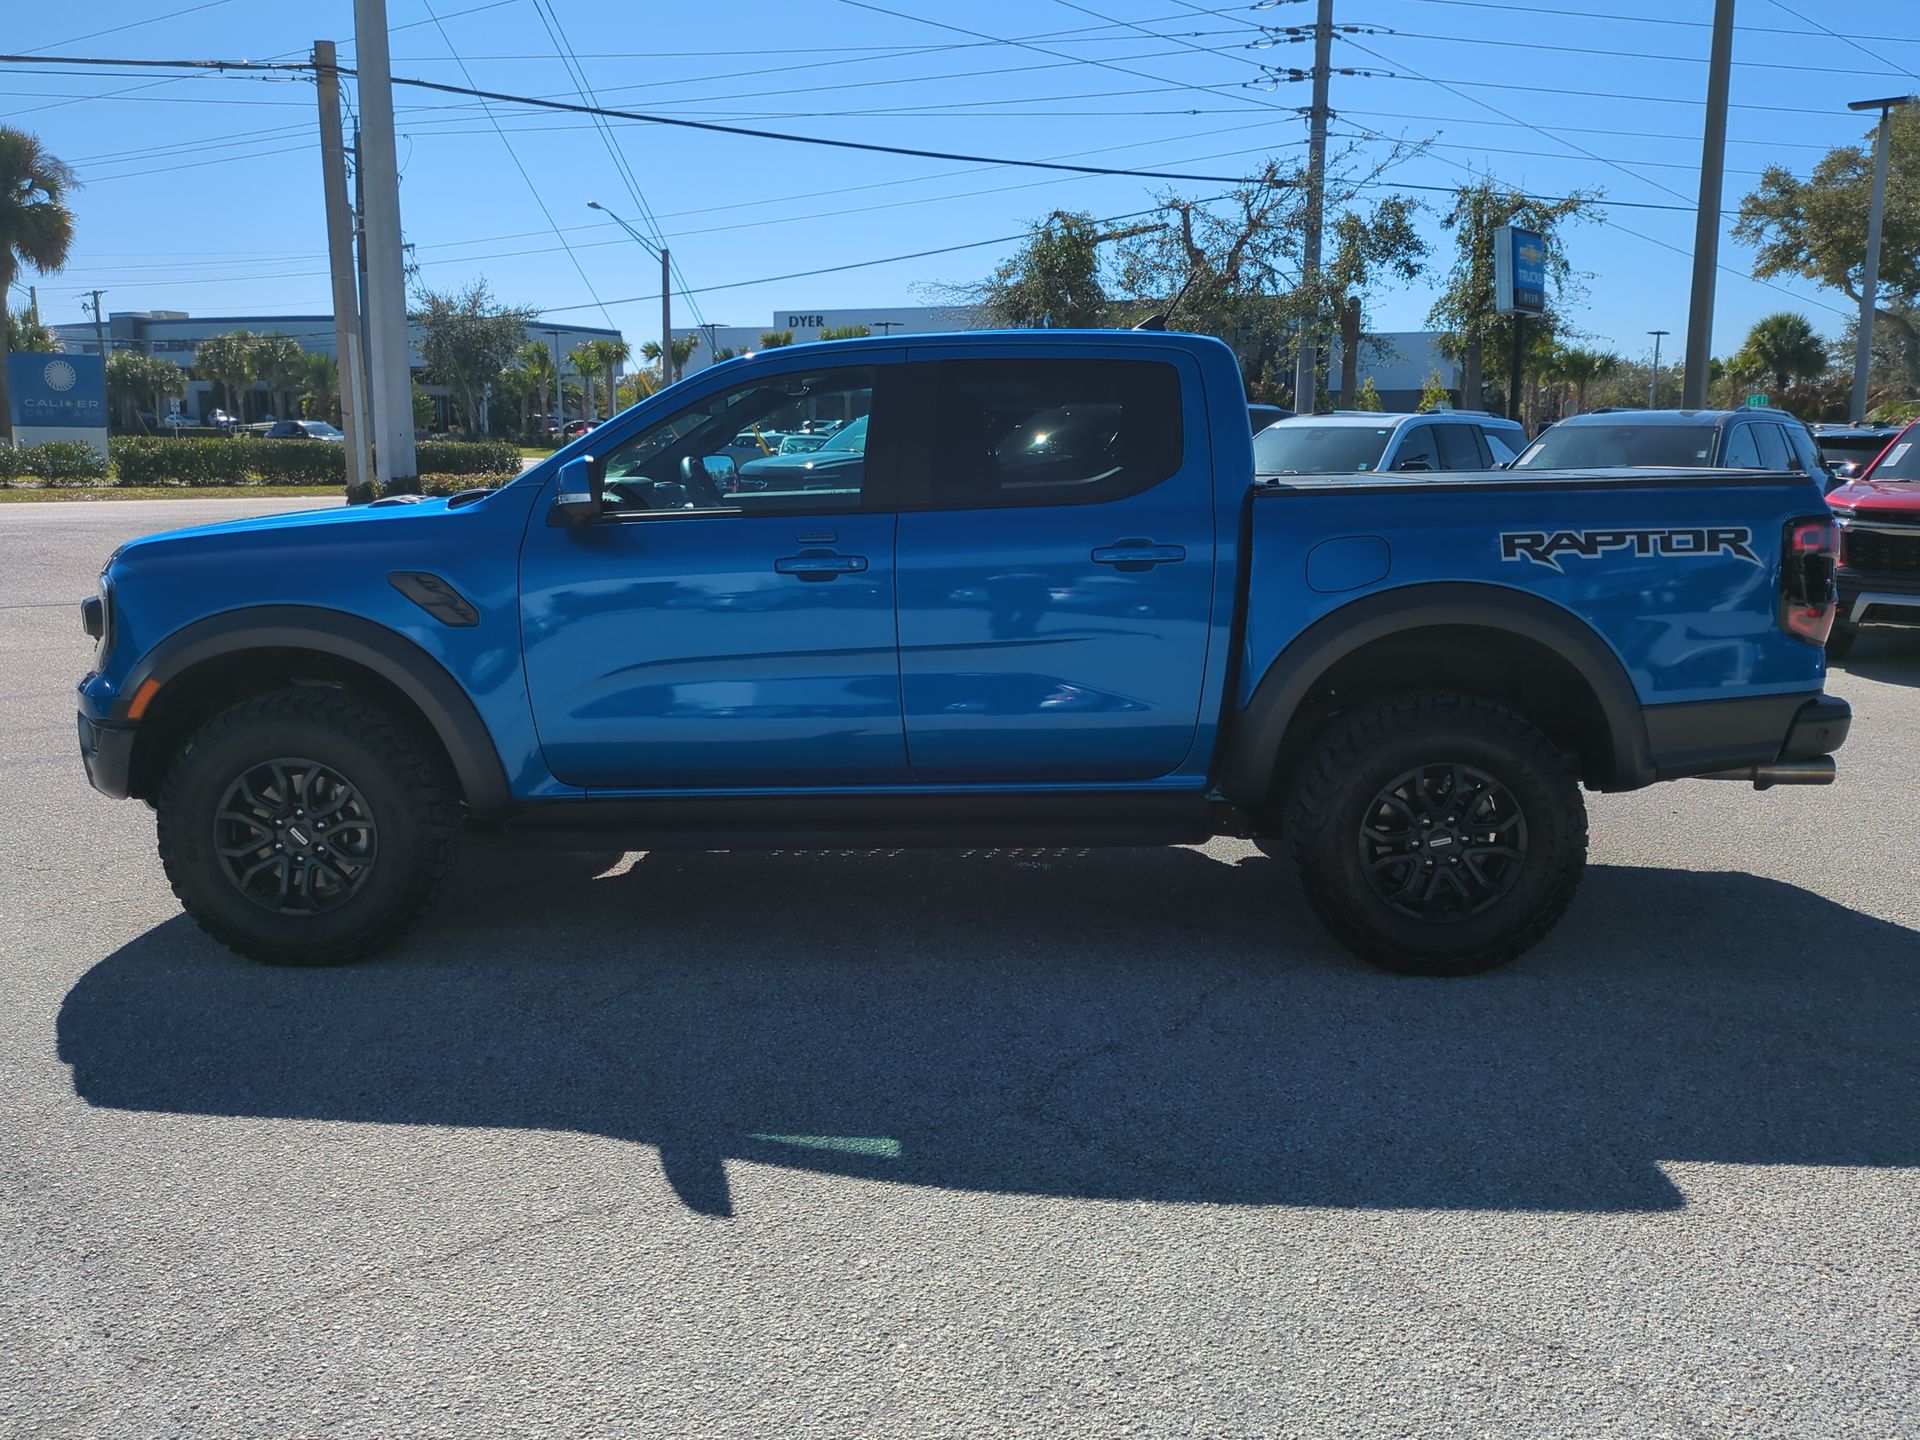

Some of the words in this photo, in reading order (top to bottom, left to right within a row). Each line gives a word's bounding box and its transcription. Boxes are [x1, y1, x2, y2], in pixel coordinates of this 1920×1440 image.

[788, 315, 824, 328] DYER
[24, 399, 99, 408] CALIER
[66, 409, 101, 418] ASH
[1499, 526, 1765, 574] RAPTOR
